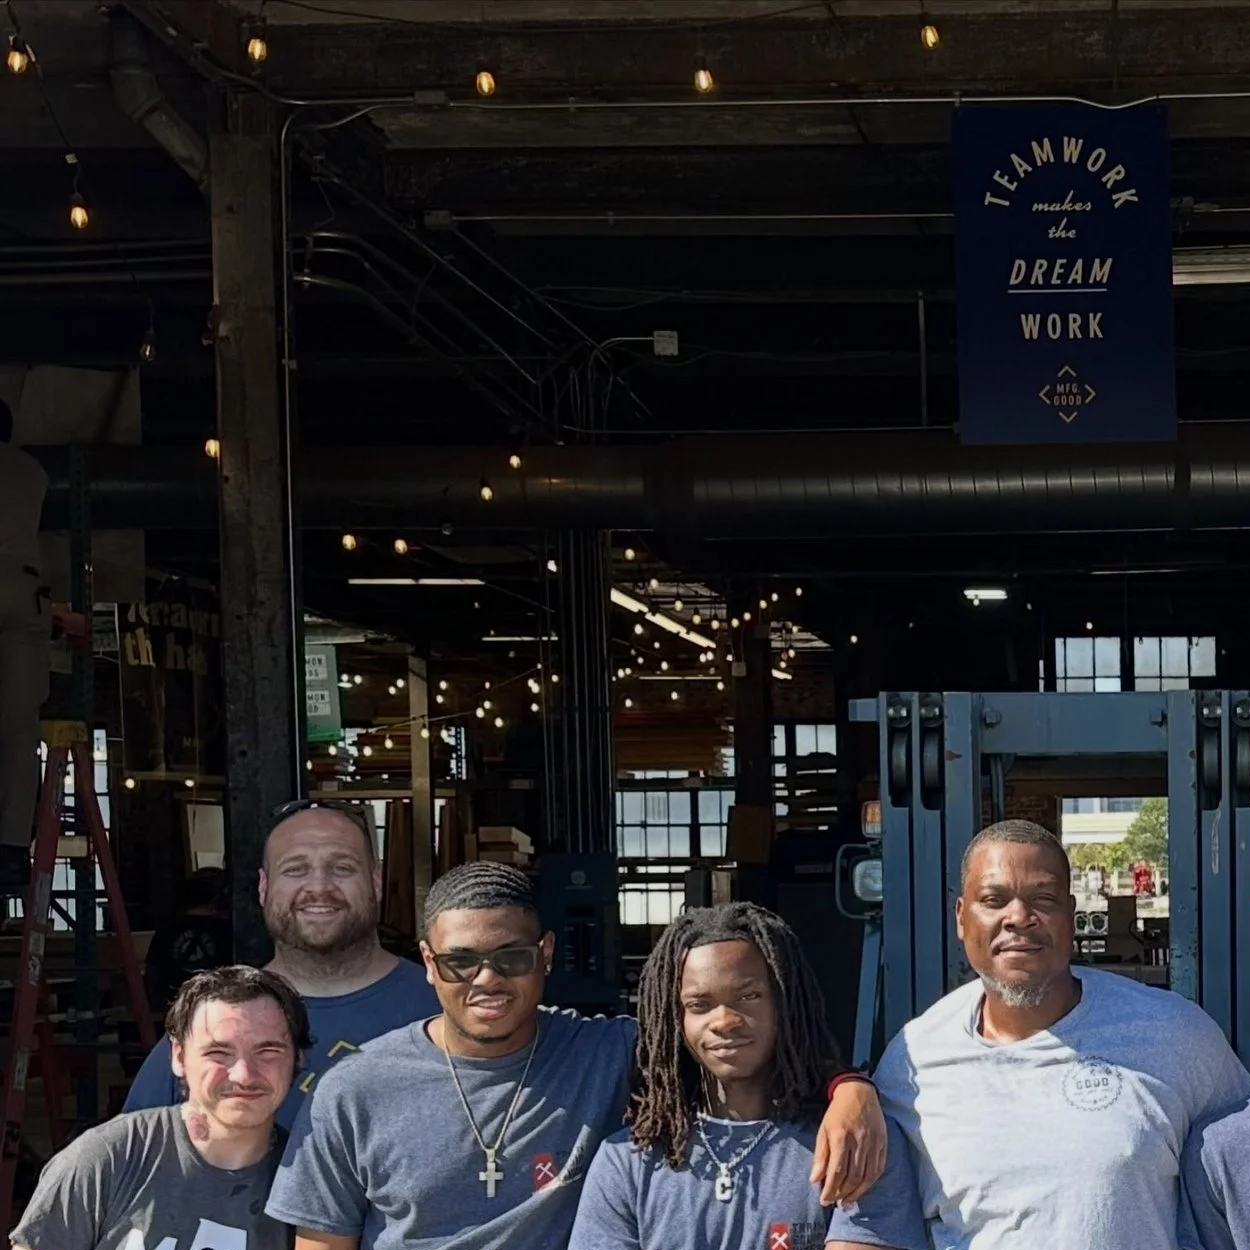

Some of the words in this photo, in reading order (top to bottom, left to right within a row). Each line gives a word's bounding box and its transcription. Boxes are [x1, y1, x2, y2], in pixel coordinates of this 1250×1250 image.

[984, 136, 1139, 209] TEAMWORK
[1032, 190, 1092, 212] makes
[1048, 217, 1077, 239] the
[1009, 258, 1112, 285] DREAM
[1021, 313, 1104, 340] WORK
